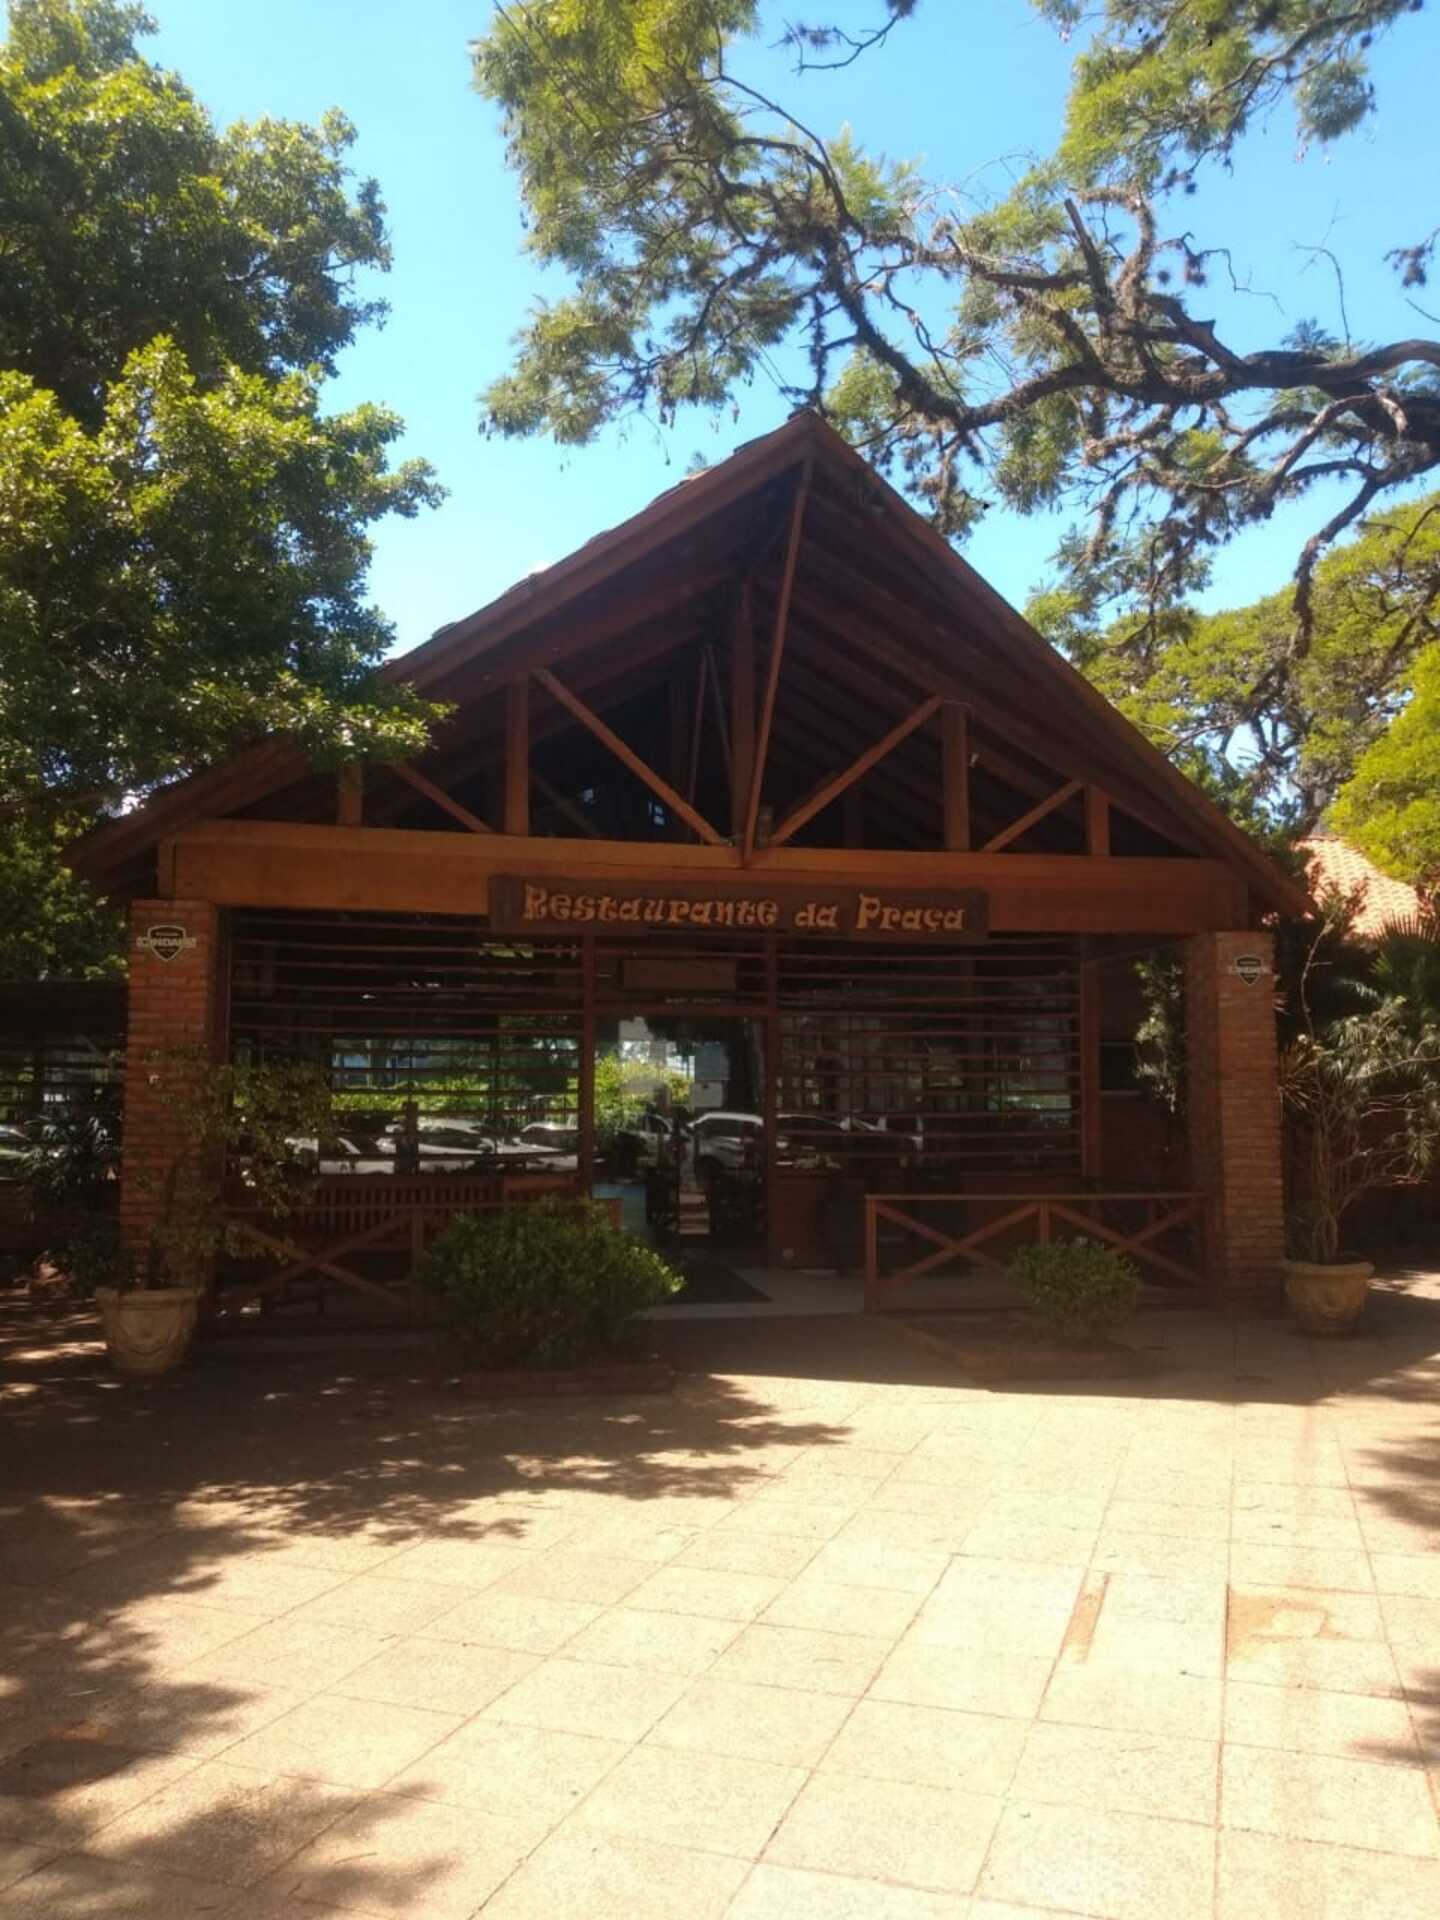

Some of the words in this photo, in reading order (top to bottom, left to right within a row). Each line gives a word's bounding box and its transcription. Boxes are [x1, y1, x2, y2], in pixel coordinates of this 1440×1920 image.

[522, 884, 779, 926] Restaurante
[795, 903, 838, 928] da
[855, 894, 966, 933] Praça
